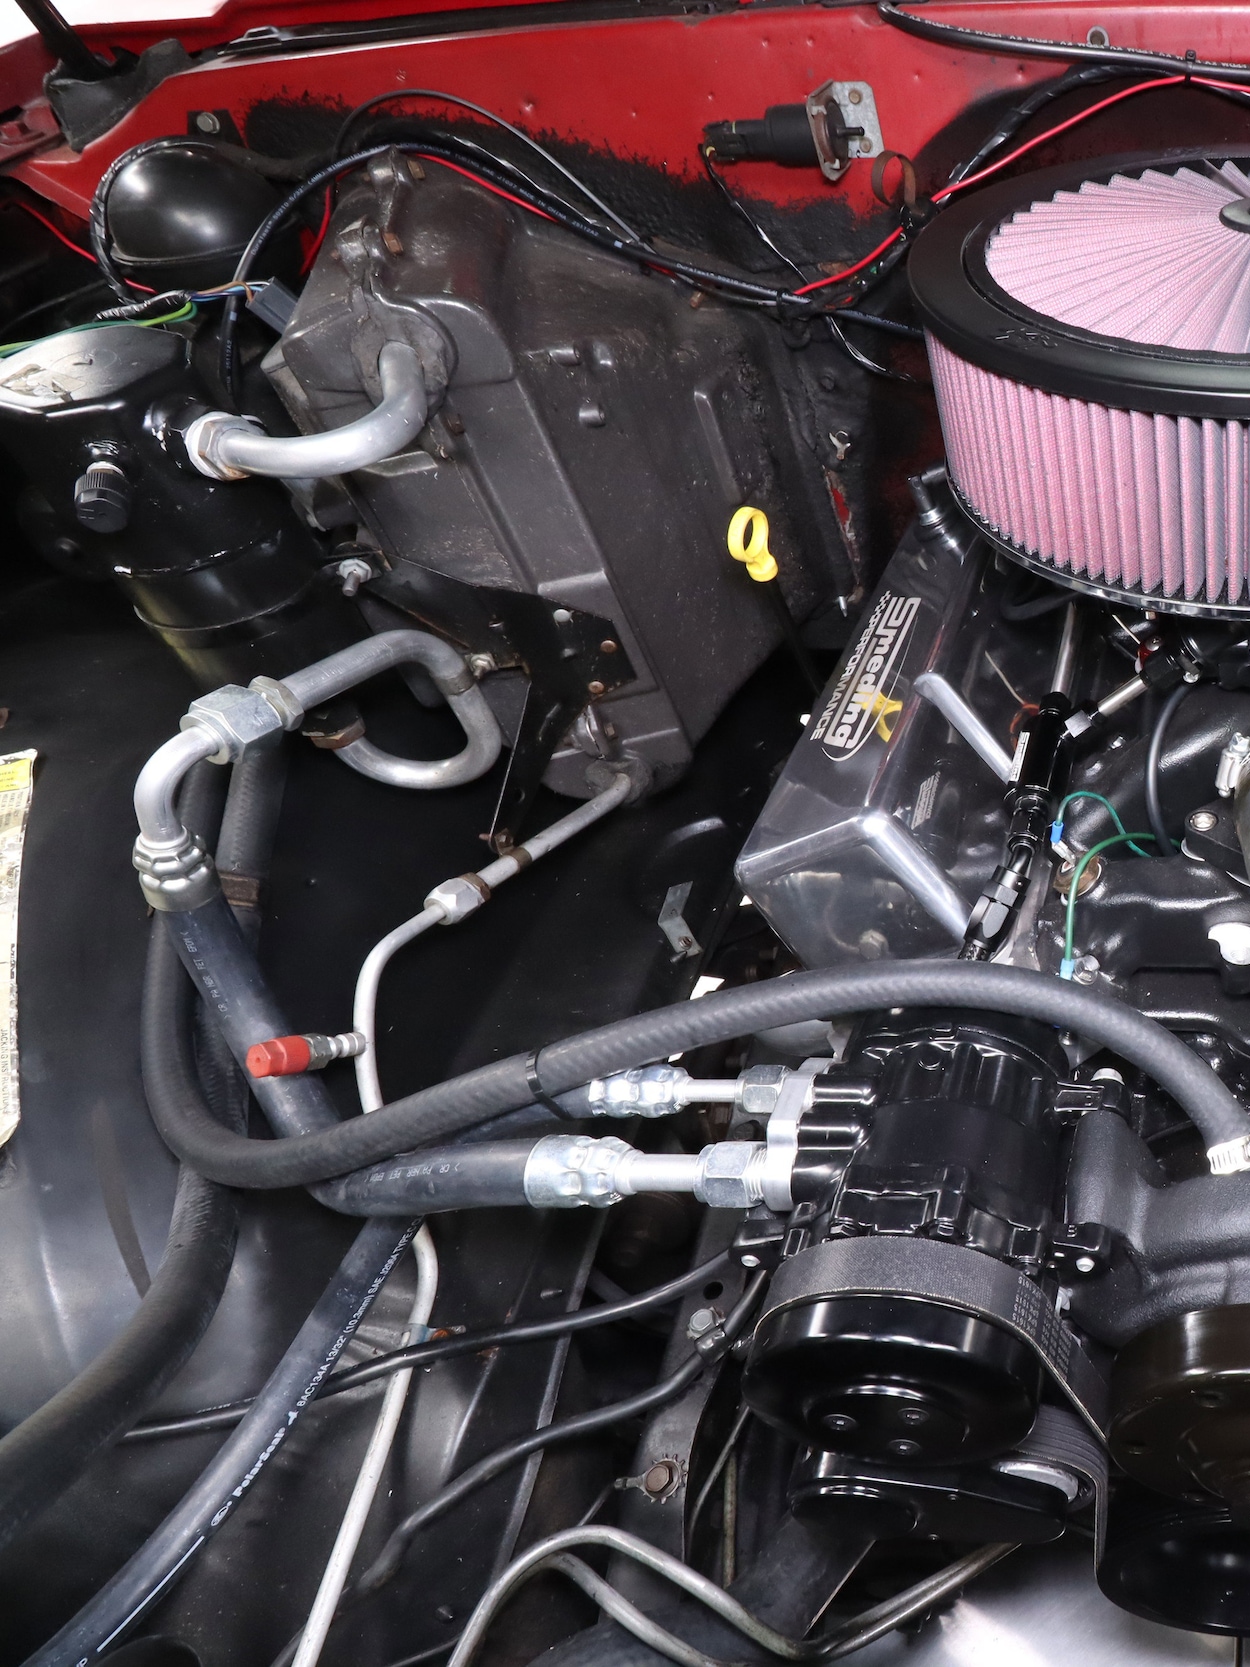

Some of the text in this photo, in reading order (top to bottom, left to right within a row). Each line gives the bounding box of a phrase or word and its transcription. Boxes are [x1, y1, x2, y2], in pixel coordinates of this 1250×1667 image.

[809, 613, 882, 741] PERFORMANCE
[823, 595, 922, 750] Smeding
[0, 1028, 9, 1060] JACKING
